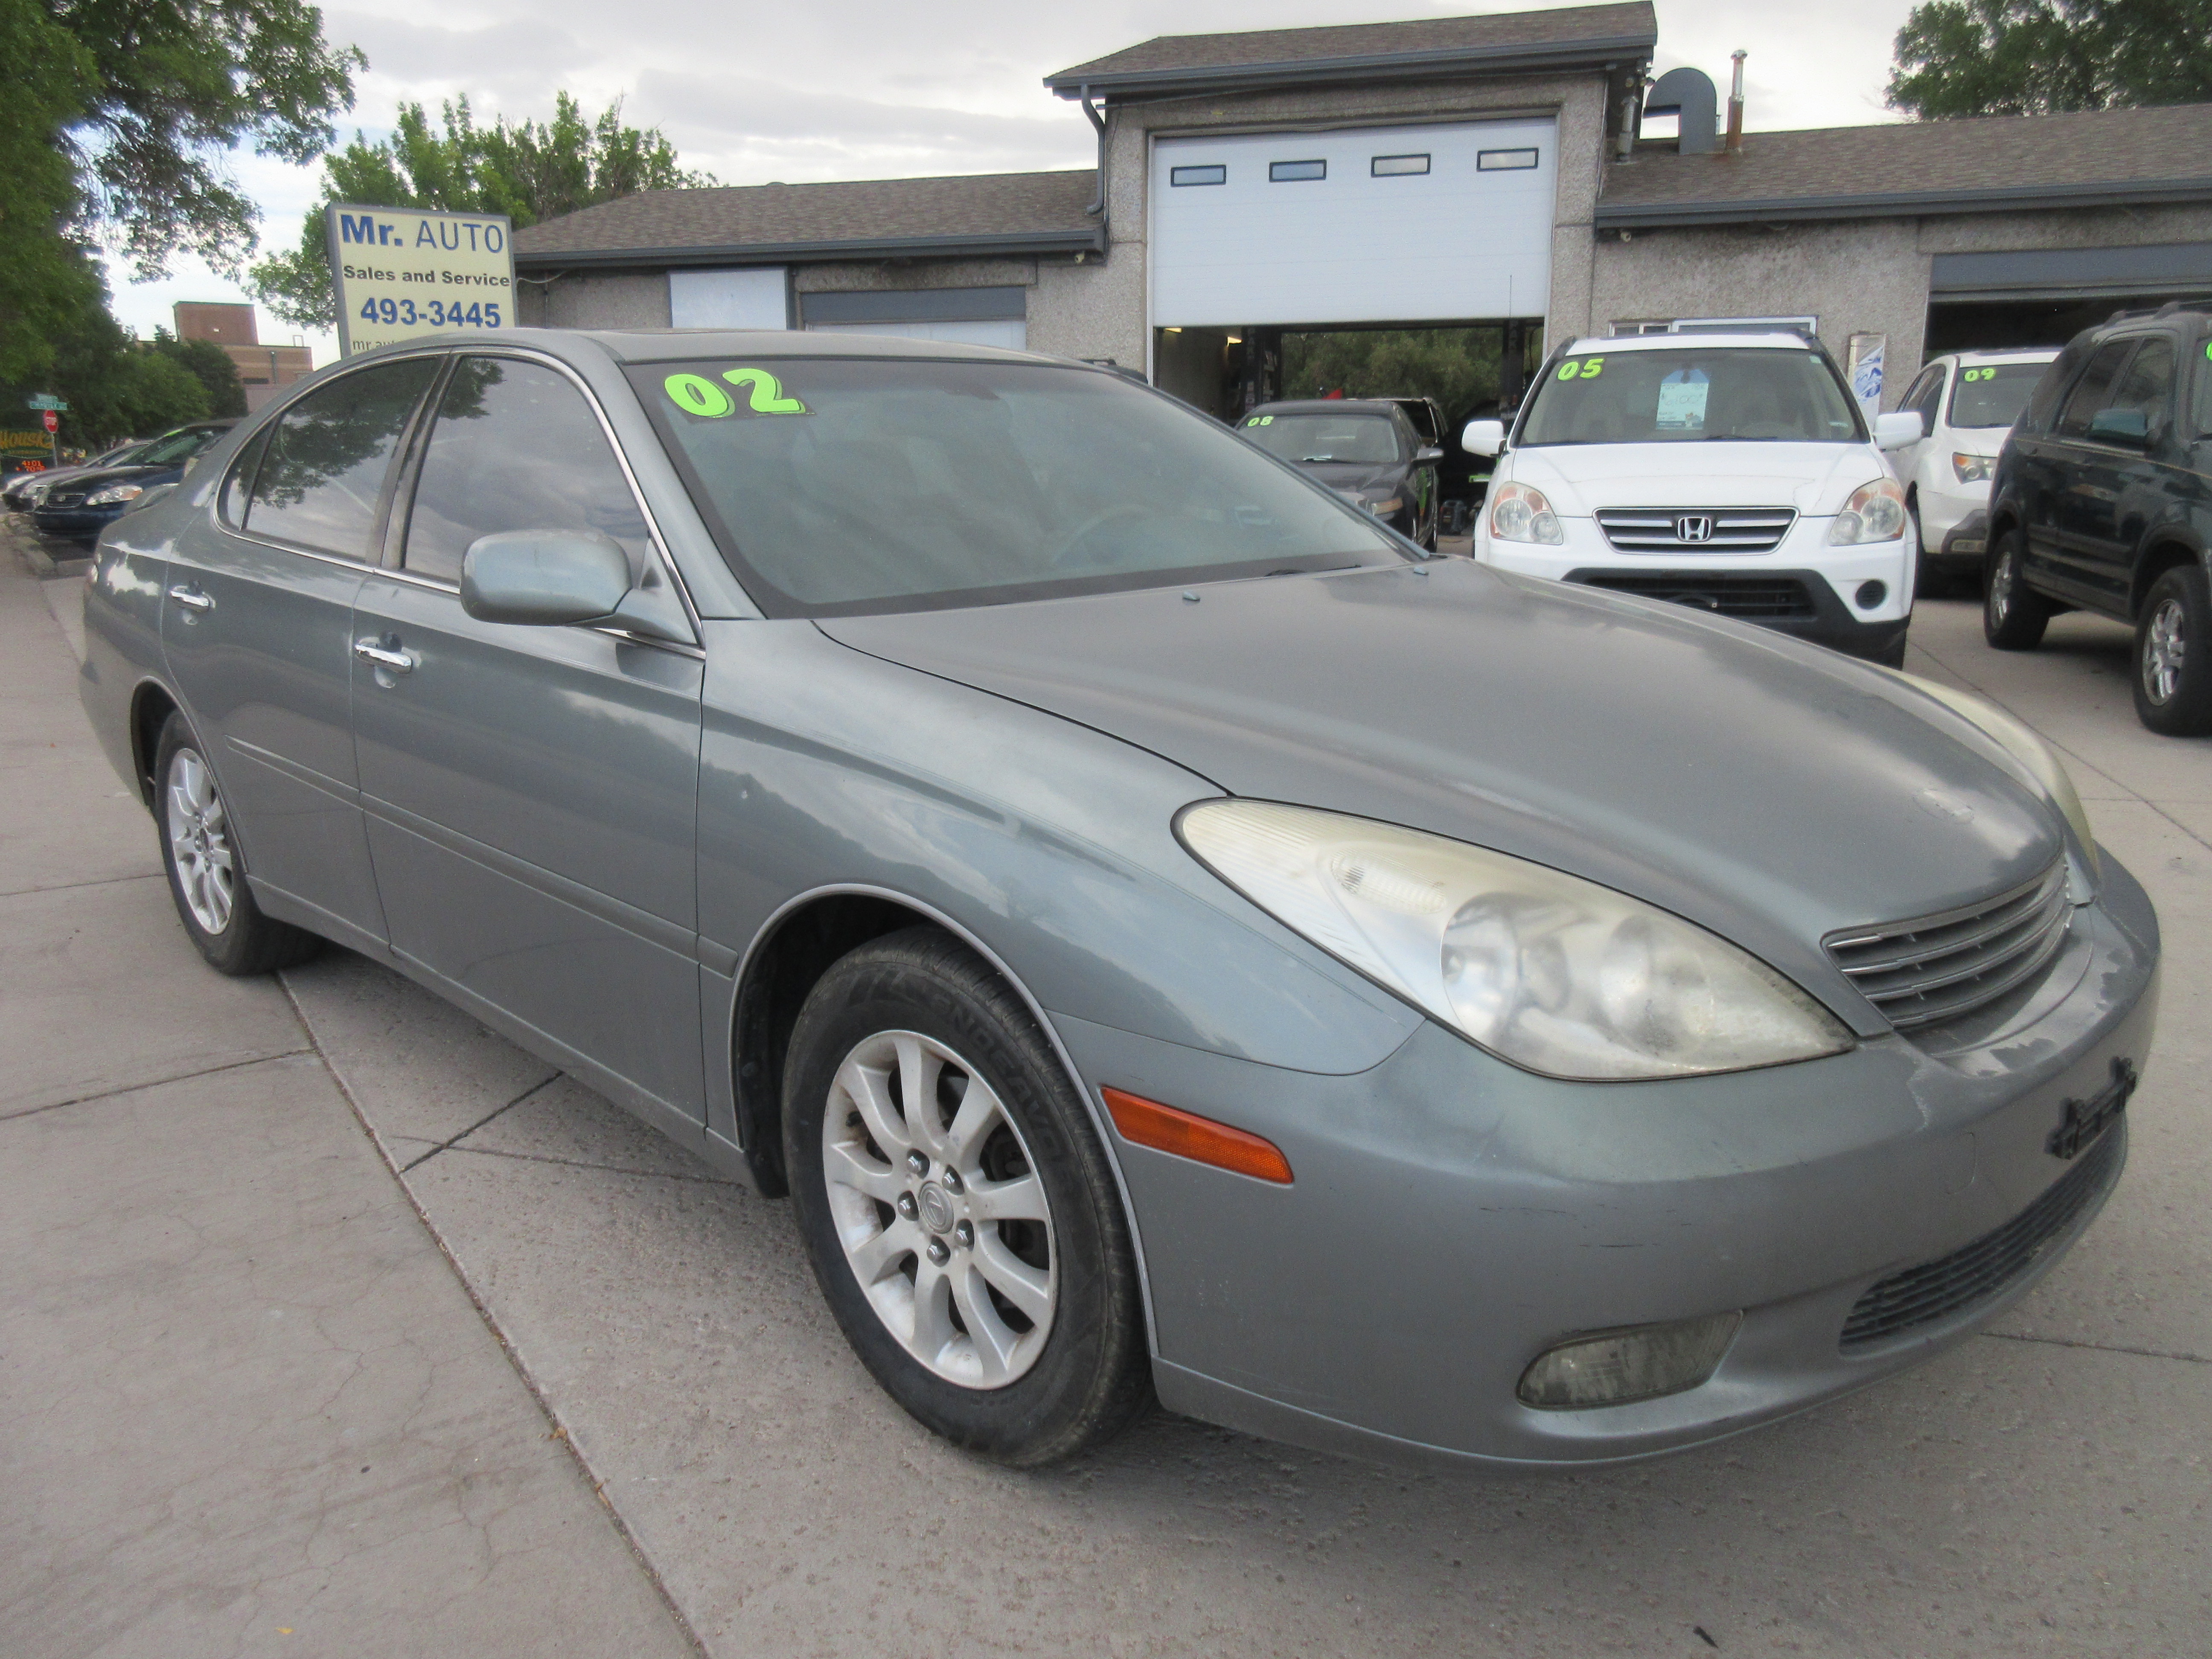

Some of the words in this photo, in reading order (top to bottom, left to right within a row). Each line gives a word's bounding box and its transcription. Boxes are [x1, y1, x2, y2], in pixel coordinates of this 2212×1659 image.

[341, 214, 403, 246] Mr.
[416, 220, 504, 253] AUTO
[343, 265, 396, 281] Sales
[402, 271, 435, 283] and
[442, 271, 510, 287] Service
[361, 297, 501, 329] 493-3445
[1557, 358, 1604, 381] 05
[1965, 368, 1995, 382] 09
[664, 368, 806, 418] 02
[1247, 416, 1274, 427] 08
